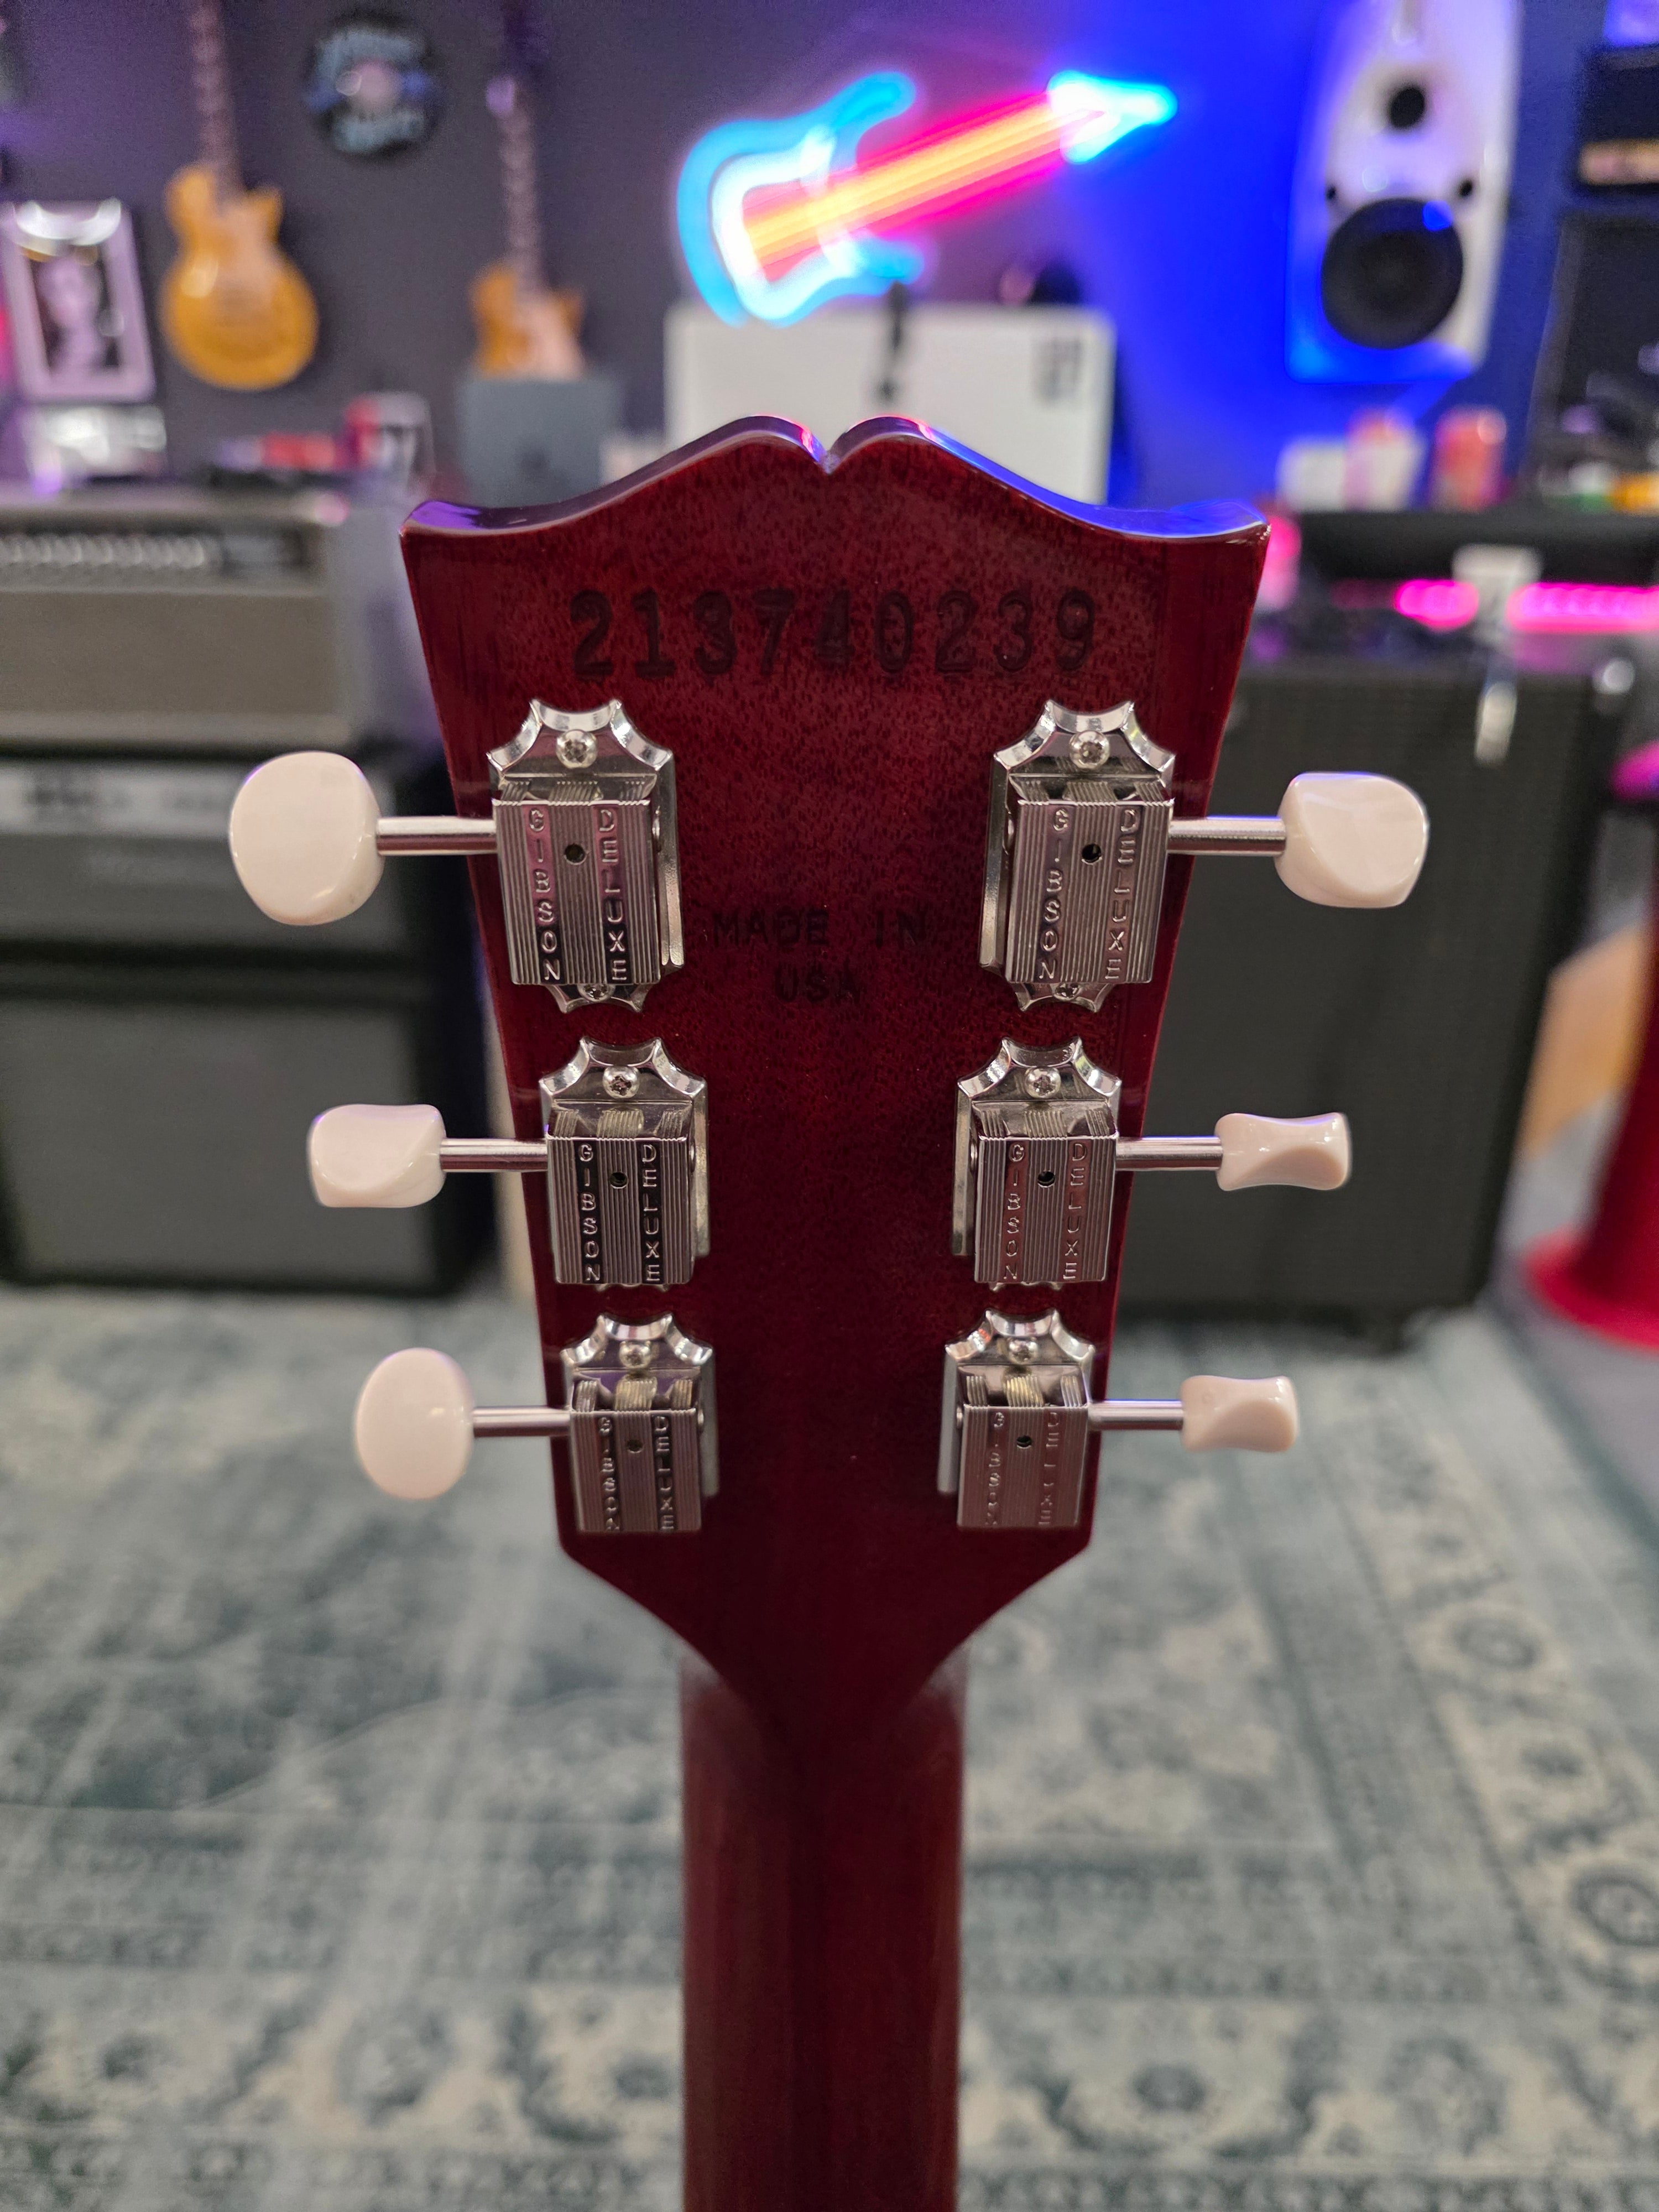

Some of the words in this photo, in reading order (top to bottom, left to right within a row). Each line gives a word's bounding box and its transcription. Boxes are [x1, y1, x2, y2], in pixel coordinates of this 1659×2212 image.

[569, 588, 1096, 681] 213740239
[528, 809, 561, 981] GIBSON
[599, 809, 627, 981] DELUXE
[713, 907, 828, 946] MADE
[875, 909, 926, 948] IN
[1039, 808, 1070, 979] GIBSON
[1105, 808, 1139, 979] DELUXE
[776, 959, 860, 1003] USA
[579, 1143, 600, 1281] GIBSON
[642, 1144, 660, 1281] DELUXE
[1003, 1143, 1024, 1280] GIBSON
[1063, 1143, 1087, 1280] DELUXE
